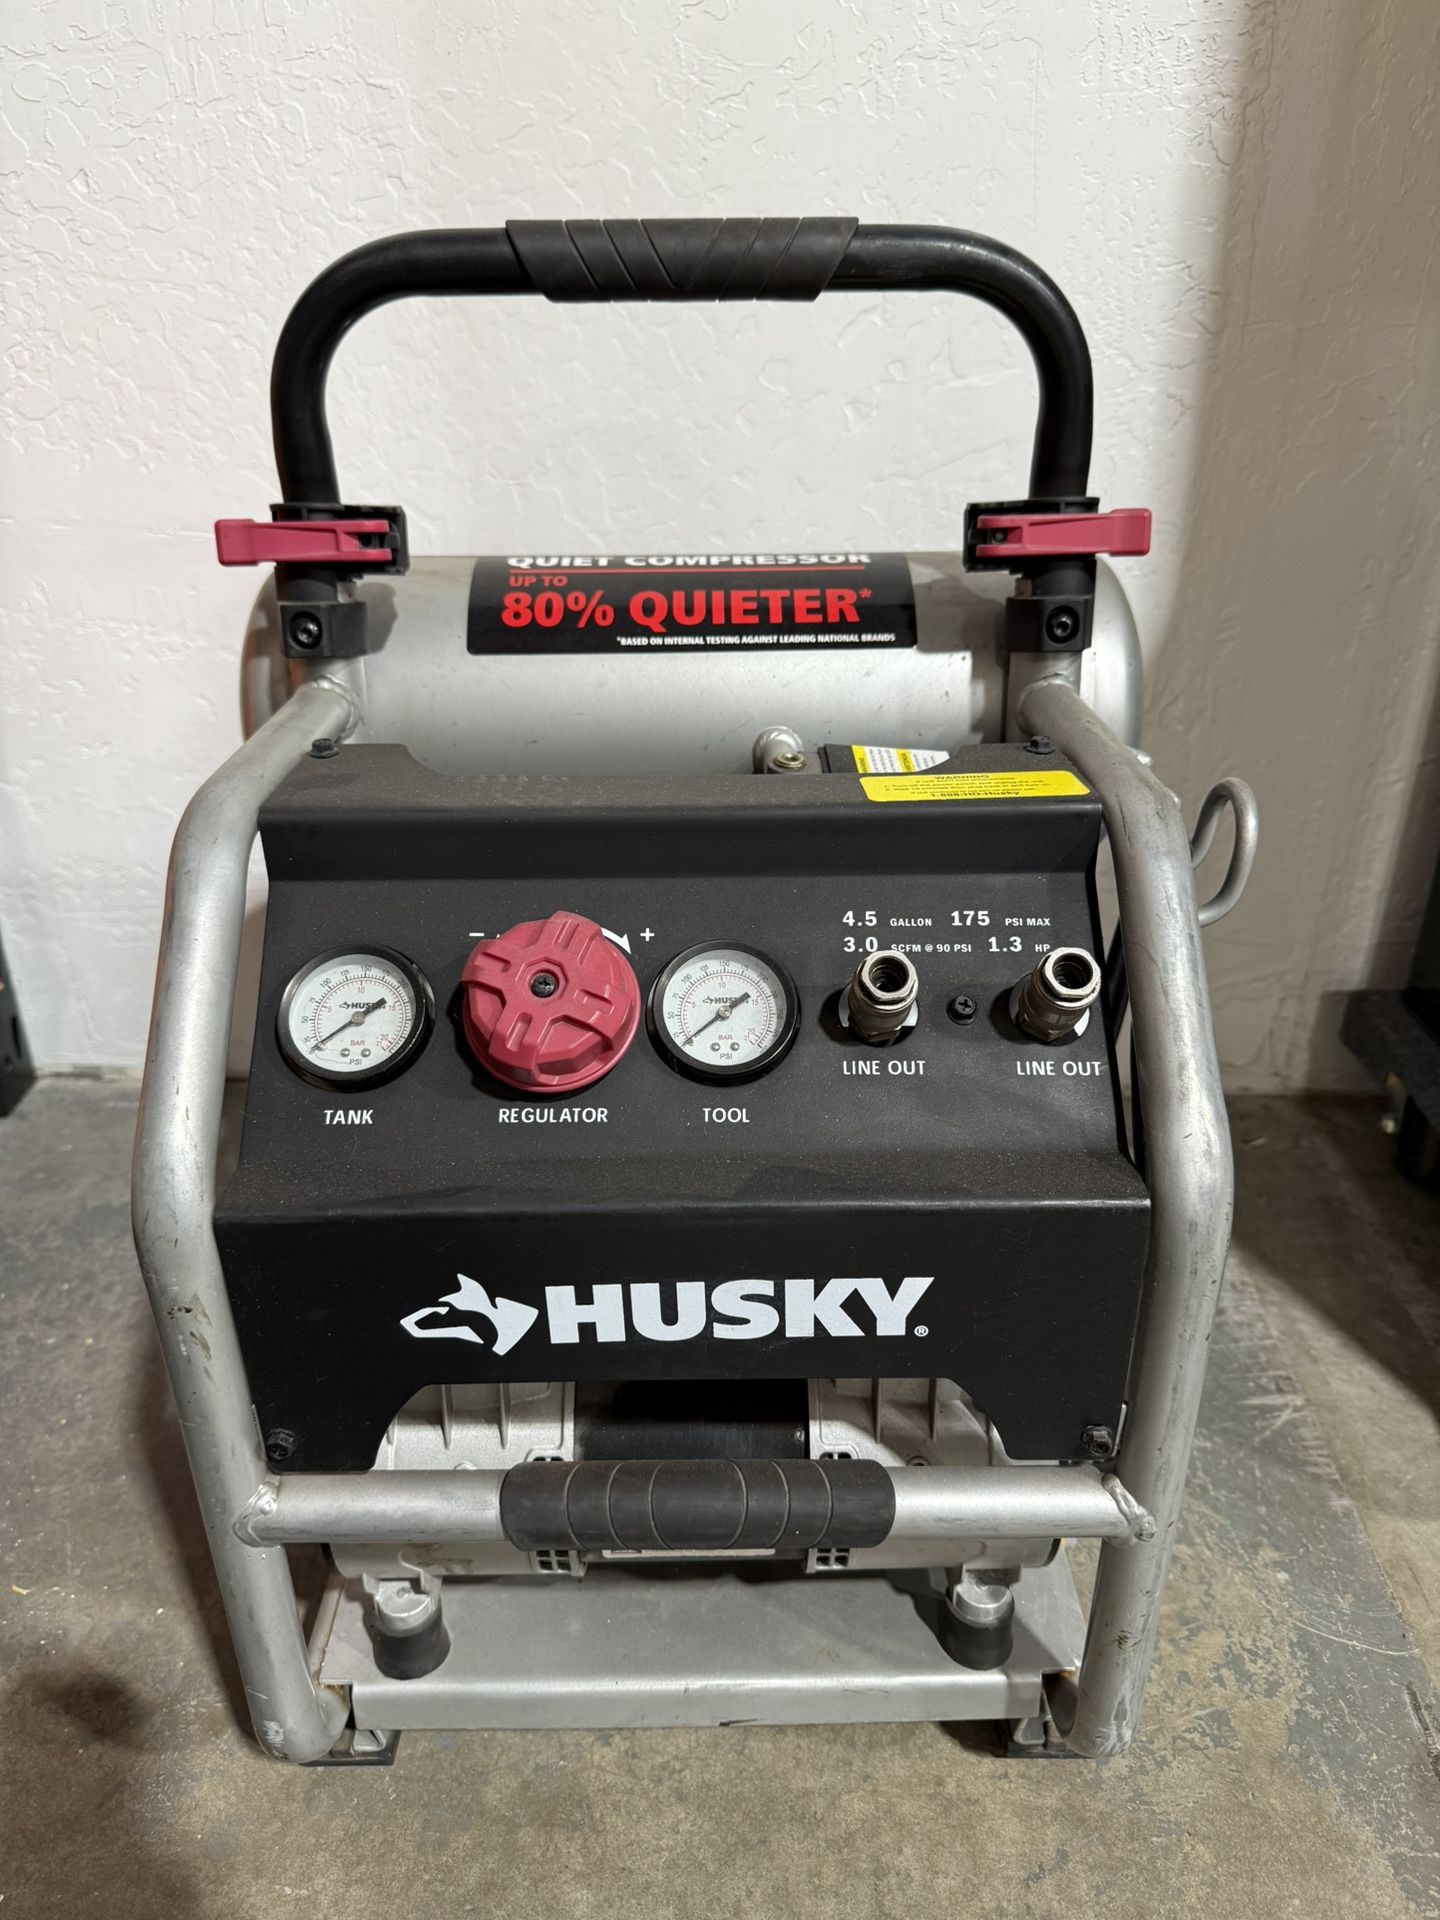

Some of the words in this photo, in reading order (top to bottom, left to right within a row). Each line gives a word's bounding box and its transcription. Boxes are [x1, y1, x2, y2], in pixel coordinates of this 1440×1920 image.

[507, 556, 614, 568] QUIET
[509, 576, 536, 587] UP
[542, 575, 568, 587] TO
[501, 590, 615, 628] 80%
[650, 637, 663, 645] ON
[664, 636, 705, 645] INTERNAL
[706, 635, 740, 645] TESTING
[741, 635, 779, 644] AGAINST
[779, 634, 816, 644] LEADING
[817, 634, 859, 643] NATIONAL
[861, 633, 896, 642] BRANDS
[842, 910, 878, 927] 4.5
[889, 918, 933, 927] GALLON
[951, 910, 991, 927] 175
[1004, 917, 1023, 926] PSI
[1026, 917, 1051, 926] MAX
[843, 936, 879, 953] 3.0
[891, 943, 922, 953] SCFM
[936, 943, 951, 952] 90
[953, 943, 972, 952] PSI
[988, 936, 1023, 953] 1.3
[1034, 943, 1051, 953] HP
[843, 1060, 881, 1076] LINE
[888, 1060, 926, 1076] OUT
[1016, 1061, 1055, 1076] LINE
[1062, 1061, 1102, 1077] OUT
[323, 1109, 374, 1125] TANK
[498, 1107, 609, 1124] REGULATOR
[702, 1107, 750, 1124] TOOL
